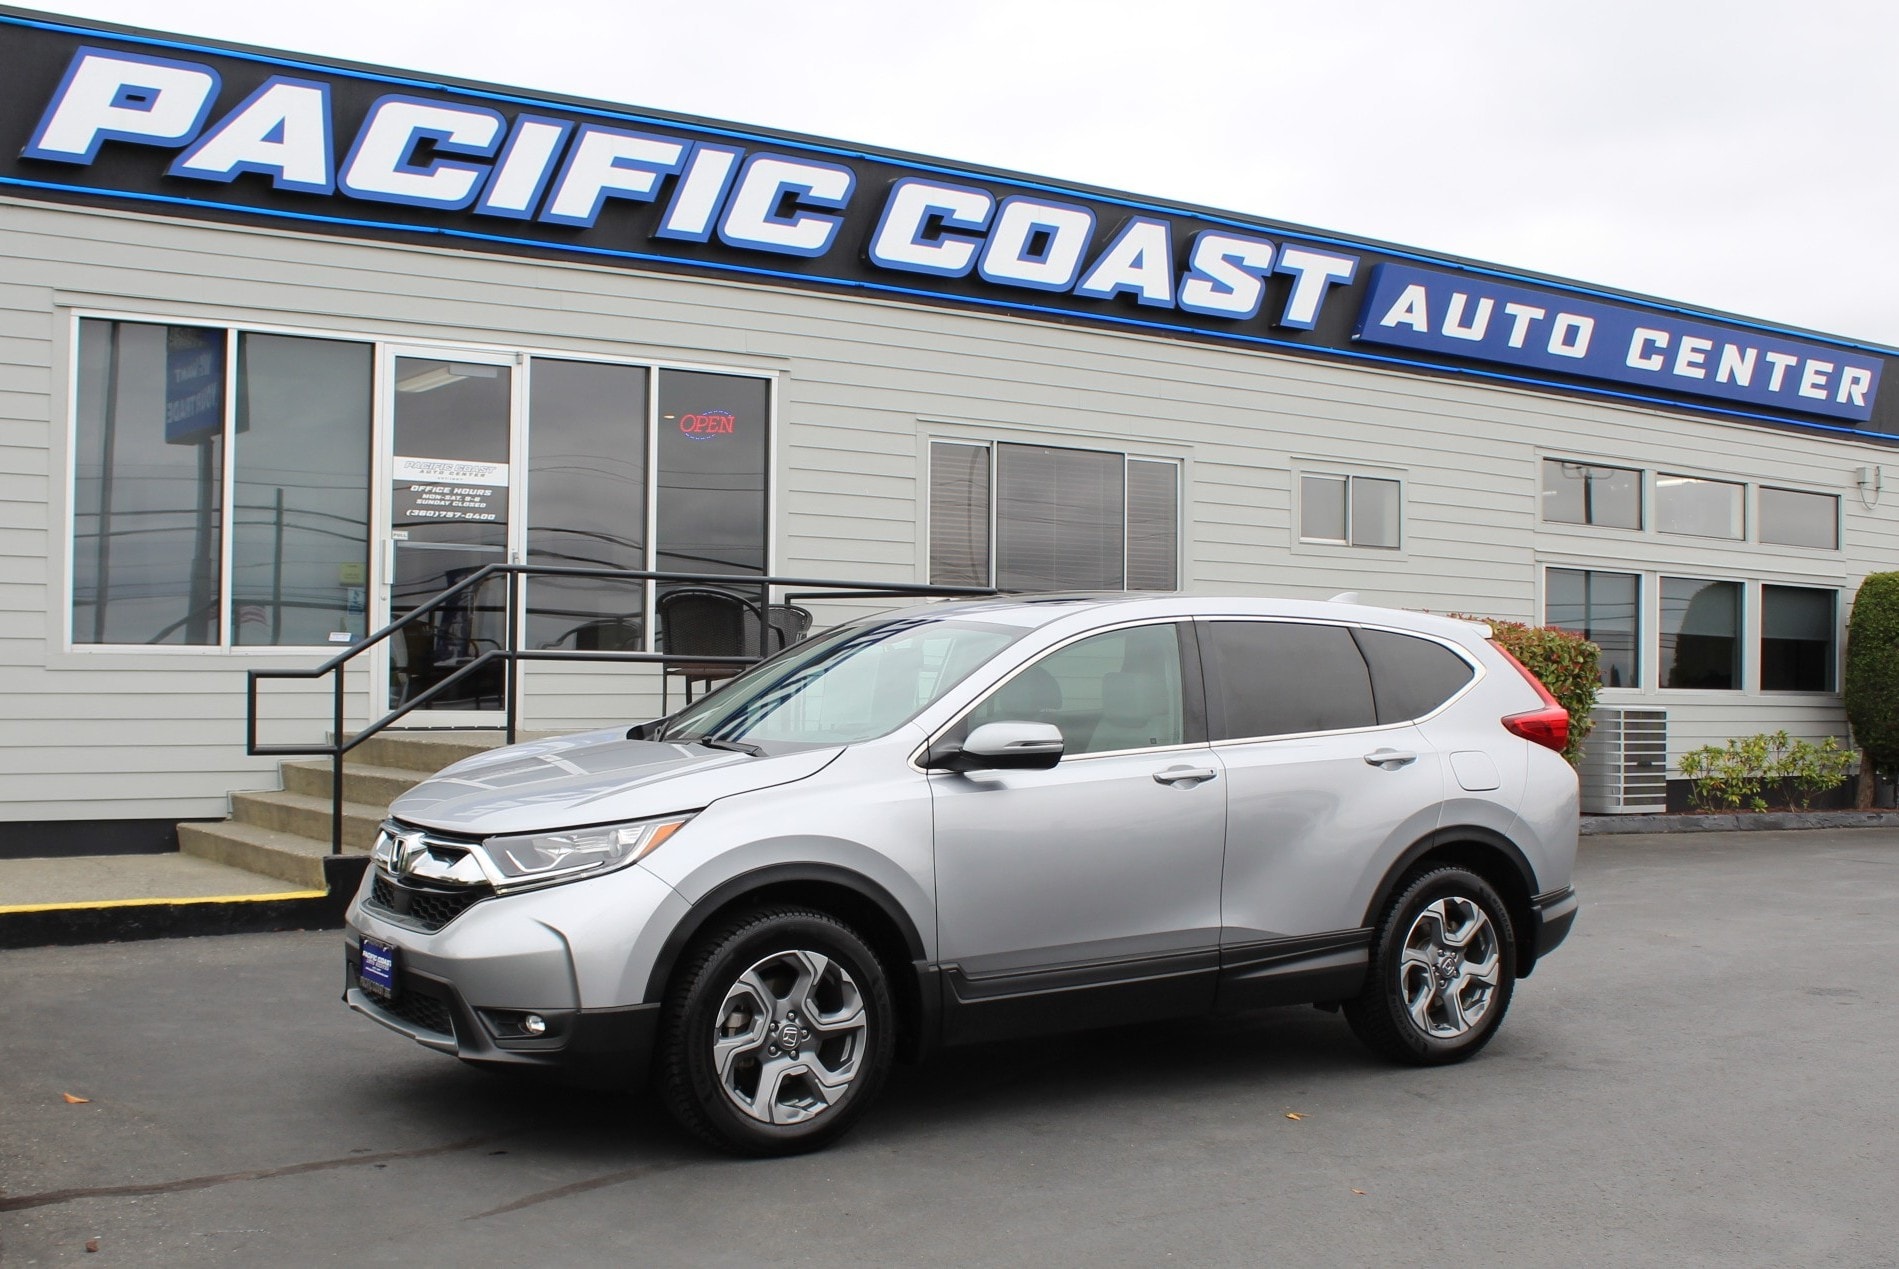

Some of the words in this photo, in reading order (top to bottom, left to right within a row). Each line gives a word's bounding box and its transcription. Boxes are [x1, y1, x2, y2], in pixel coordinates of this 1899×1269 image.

[19, 45, 857, 257] PACIFIC
[869, 177, 1361, 330] COAST
[1379, 284, 1595, 359] AUTO
[1625, 327, 1872, 407] CENTER
[680, 414, 735, 433] OPEN
[404, 461, 453, 471] PACIFIC
[454, 463, 497, 474] COAST
[410, 485, 451, 493] OFFICE
[454, 488, 492, 496] HOURS
[406, 509, 496, 520] (360)757-0400
